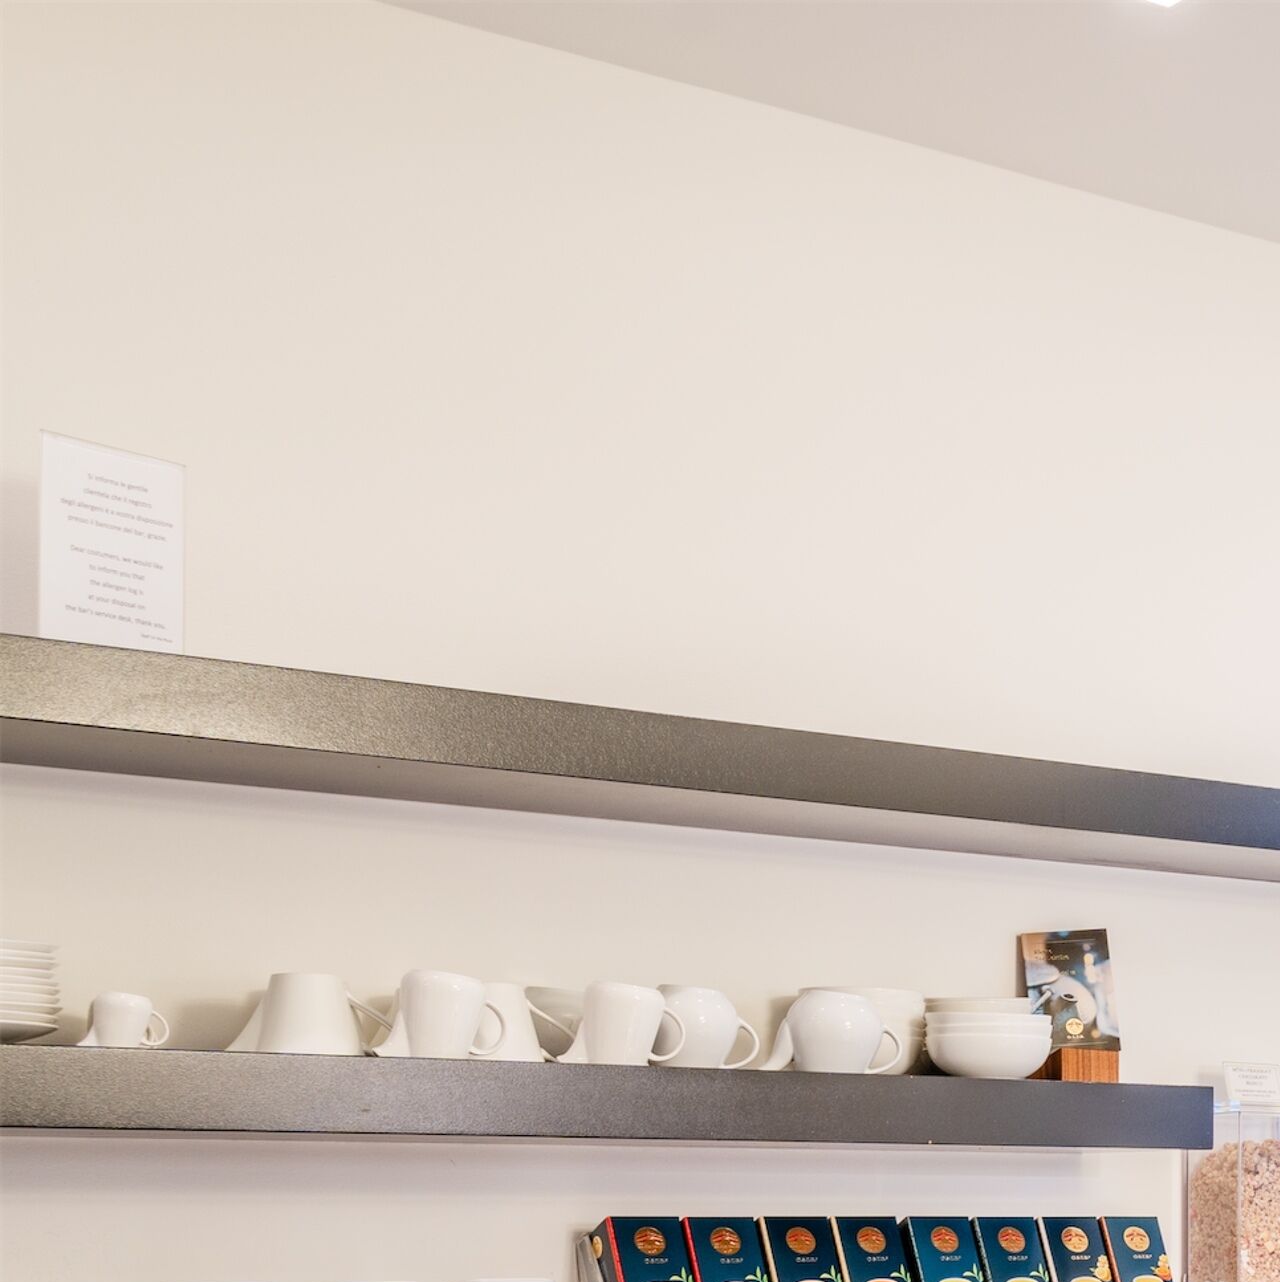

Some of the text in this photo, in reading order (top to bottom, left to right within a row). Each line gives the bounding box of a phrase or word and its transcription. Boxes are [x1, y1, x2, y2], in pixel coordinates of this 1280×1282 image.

[133, 558, 151, 568] would
[97, 566, 118, 576] inform
[120, 572, 130, 580] you
[132, 572, 145, 581] that
[90, 578, 100, 588] the
[96, 596, 110, 604] your
[111, 597, 137, 609] disposal
[65, 603, 76, 612] the
[95, 610, 116, 620] service
[134, 618, 152, 628] thank
